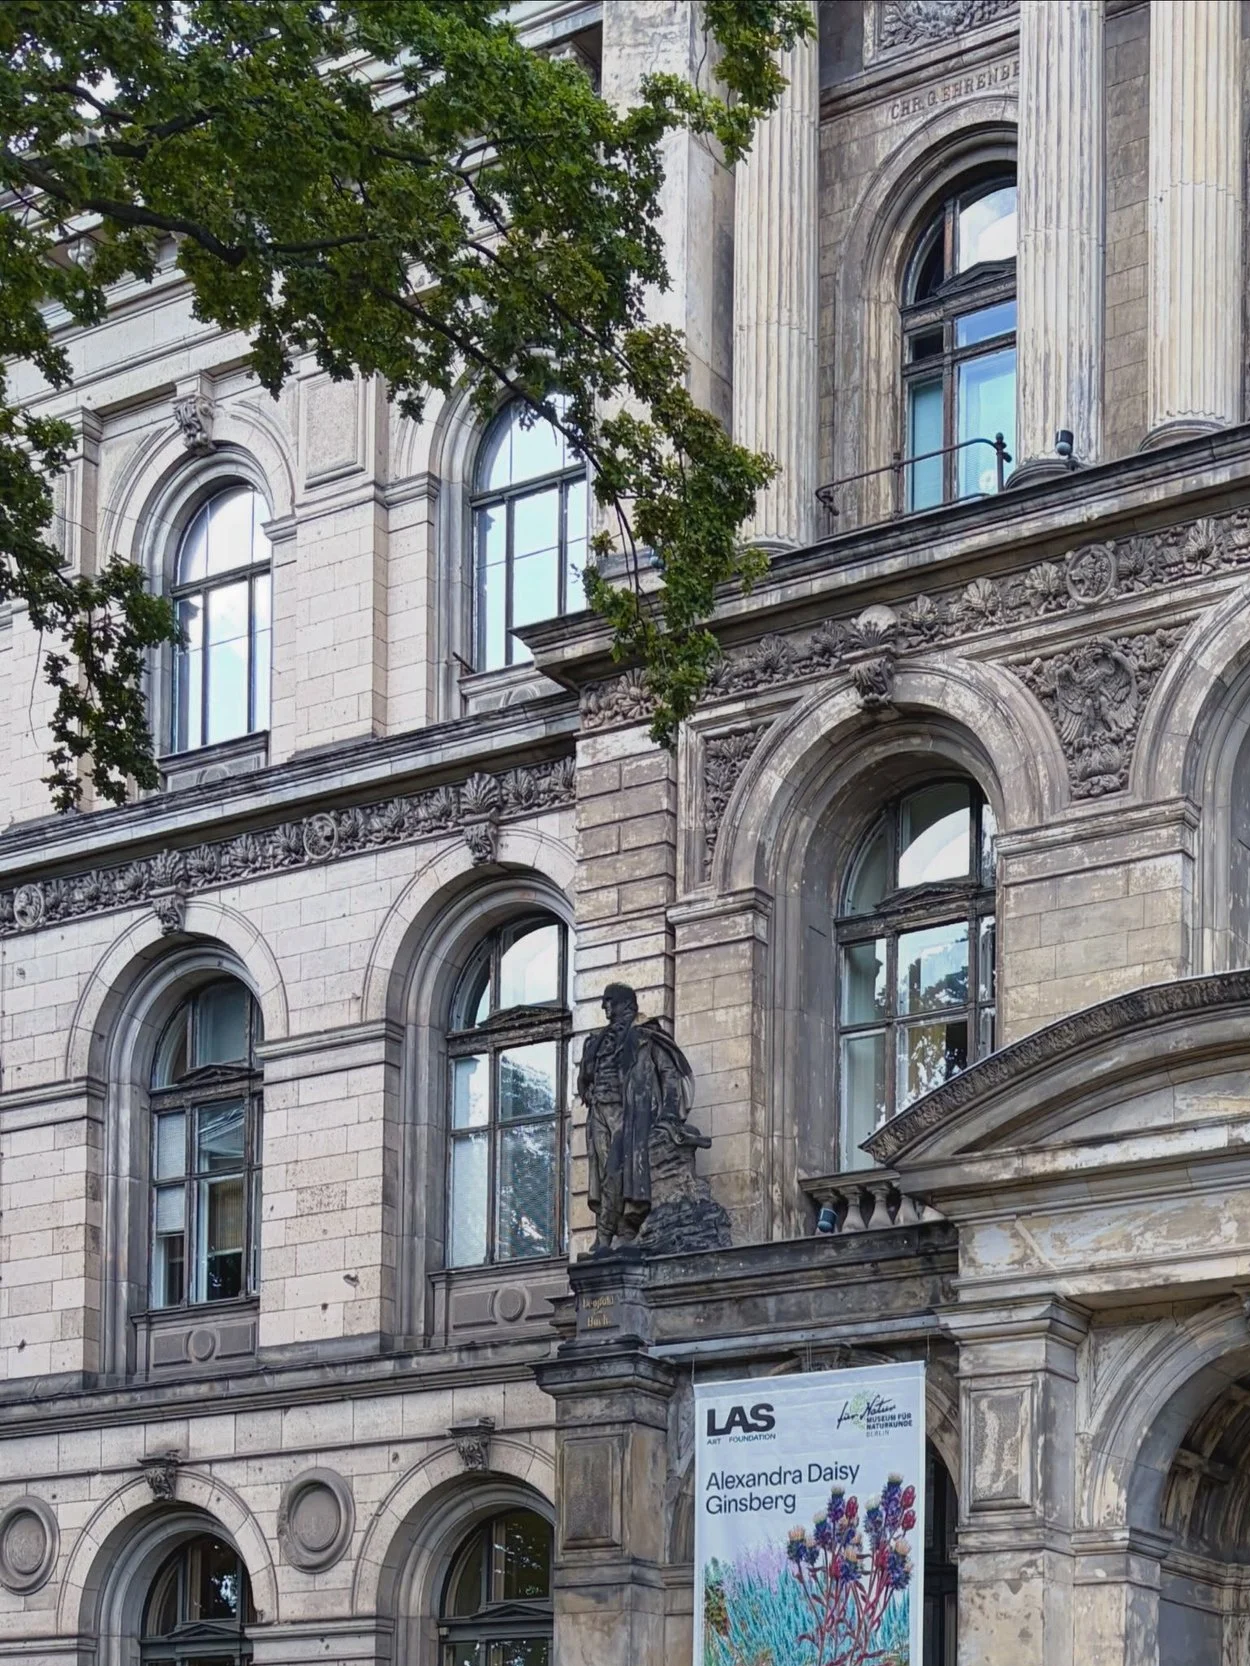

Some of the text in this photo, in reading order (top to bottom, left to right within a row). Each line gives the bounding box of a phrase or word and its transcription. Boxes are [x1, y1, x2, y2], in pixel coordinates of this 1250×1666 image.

[707, 1403, 776, 1437] LAS
[866, 1412, 912, 1423] MUSEUM FÜR
[866, 1420, 913, 1430] NATURKUNDE
[729, 1433, 776, 1443] FOUNDATION
[706, 1461, 860, 1491] Alexandra Daisy
[706, 1492, 796, 1515] Ginsberg
